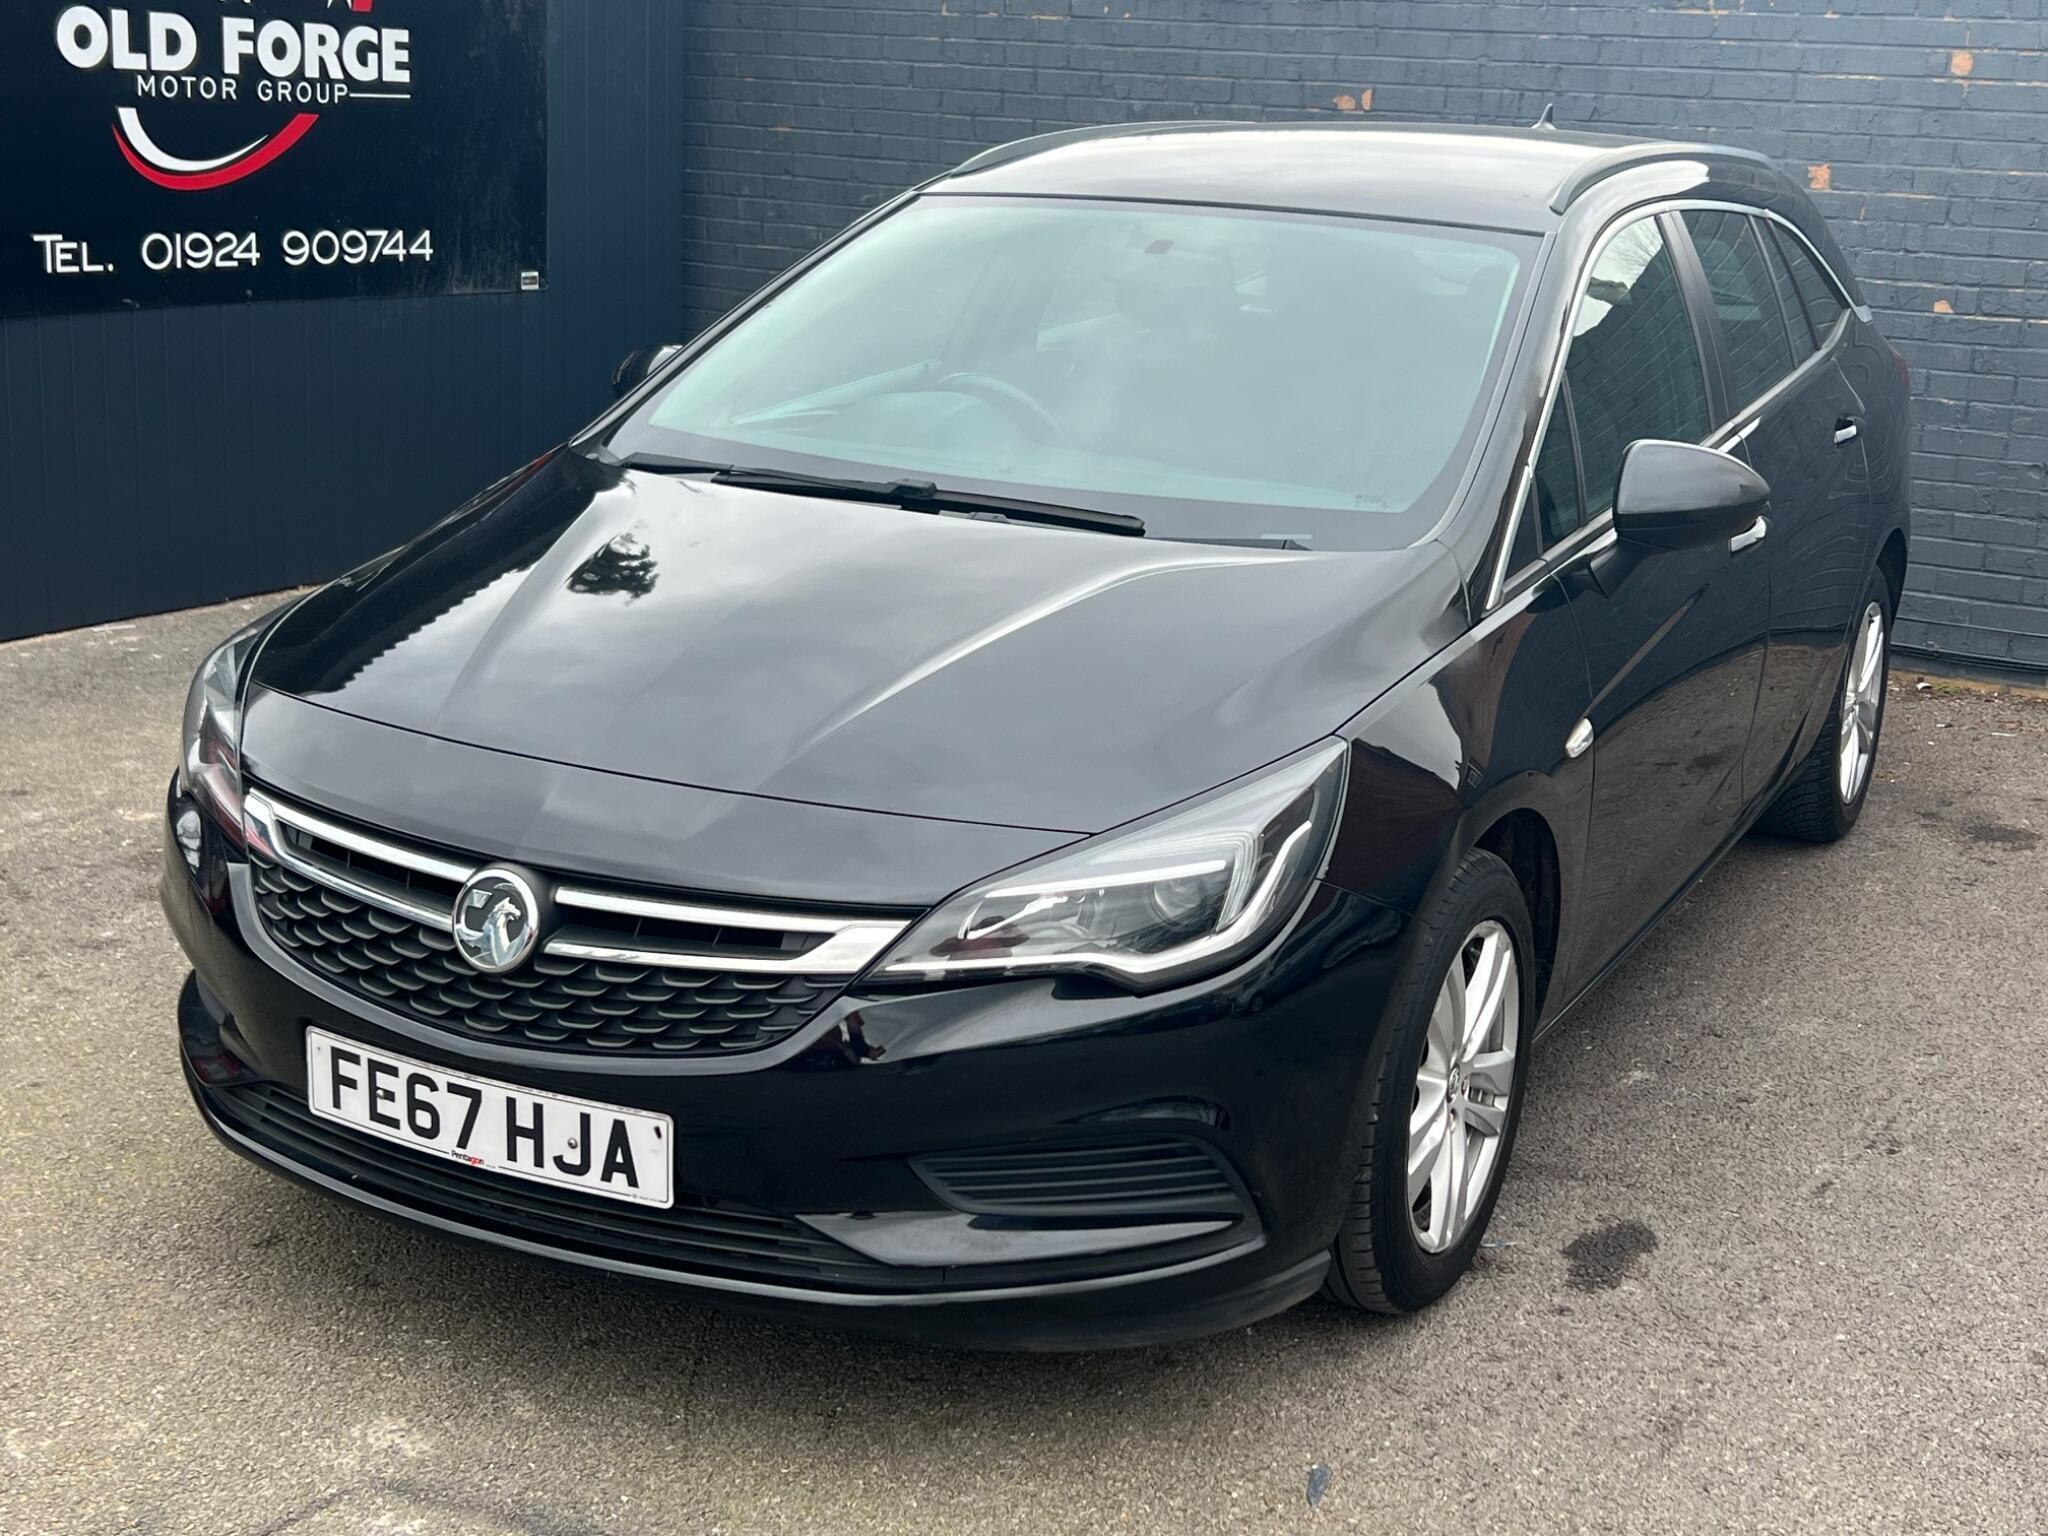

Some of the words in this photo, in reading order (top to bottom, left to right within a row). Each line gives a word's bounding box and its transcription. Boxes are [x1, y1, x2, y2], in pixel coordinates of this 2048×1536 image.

[56, 5, 197, 72] OLD
[221, 16, 411, 83] FORGE
[136, 74, 237, 100] MOTOR
[257, 79, 349, 104] GROUP
[32, 233, 114, 274] TEL.
[141, 232, 260, 269] 01924
[282, 229, 433, 266] 909744
[330, 1046, 482, 1150] FE67
[506, 1096, 640, 1190] HJA
